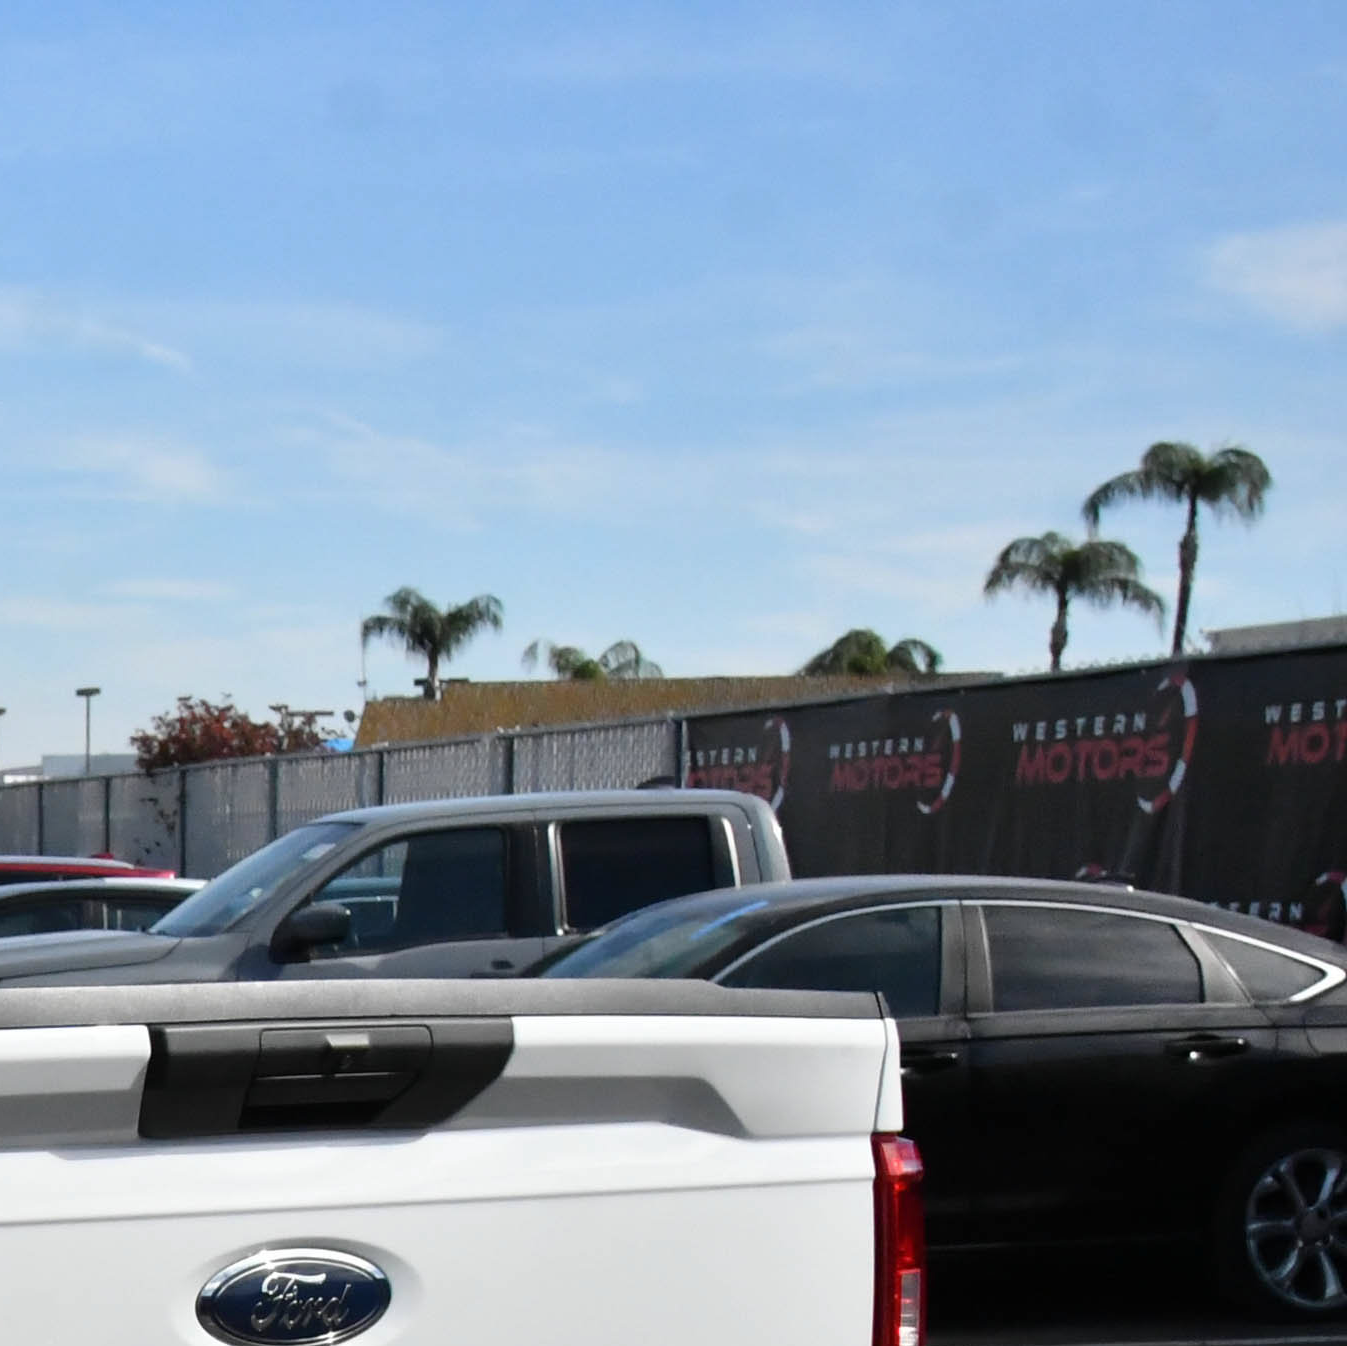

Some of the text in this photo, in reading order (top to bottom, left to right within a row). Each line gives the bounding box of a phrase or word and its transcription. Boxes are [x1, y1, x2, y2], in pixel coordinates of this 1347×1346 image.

[1012, 712, 1146, 742] WESTERN
[1265, 699, 1347, 724] WEST
[829, 737, 924, 759] WESTERN
[1016, 732, 1170, 786] MOTORS
[830, 753, 942, 792] MOTORS
[250, 1272, 352, 1331] Ford
